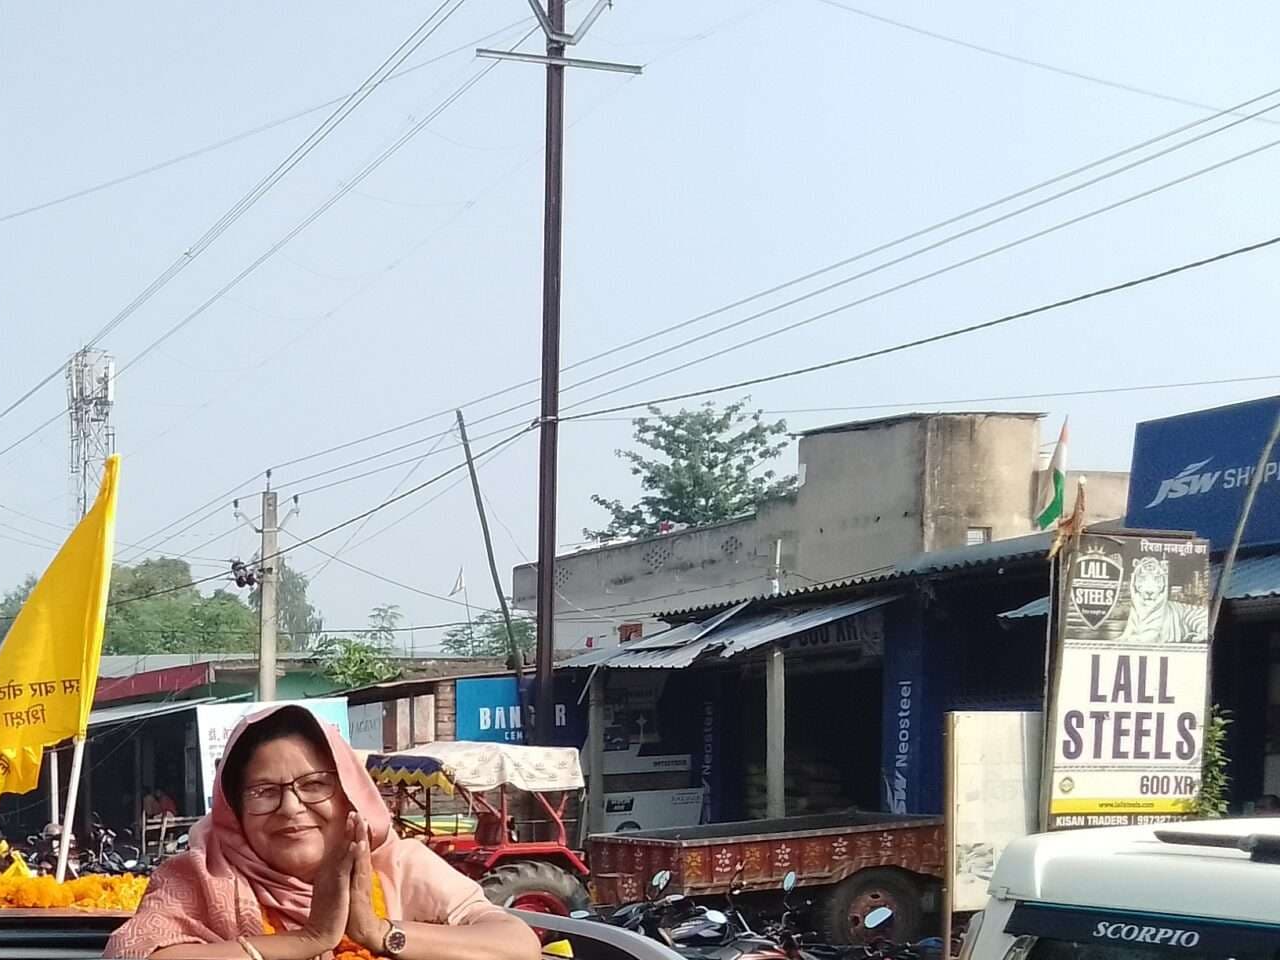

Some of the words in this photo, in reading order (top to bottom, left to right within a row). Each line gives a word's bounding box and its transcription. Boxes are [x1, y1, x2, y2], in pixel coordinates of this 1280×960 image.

[1080, 560, 1110, 579] LALL
[1075, 588, 1115, 606] STEELS
[1089, 654, 1176, 704] LALL
[479, 703, 566, 730] BANR
[895, 680, 912, 767] Neosteel
[1062, 709, 1197, 761] STEELS
[1140, 775, 1170, 796] 600
[1055, 815, 1085, 827] KISAN
[1087, 815, 1129, 826] TRADERS
[1093, 921, 1200, 948] SCORPIO
